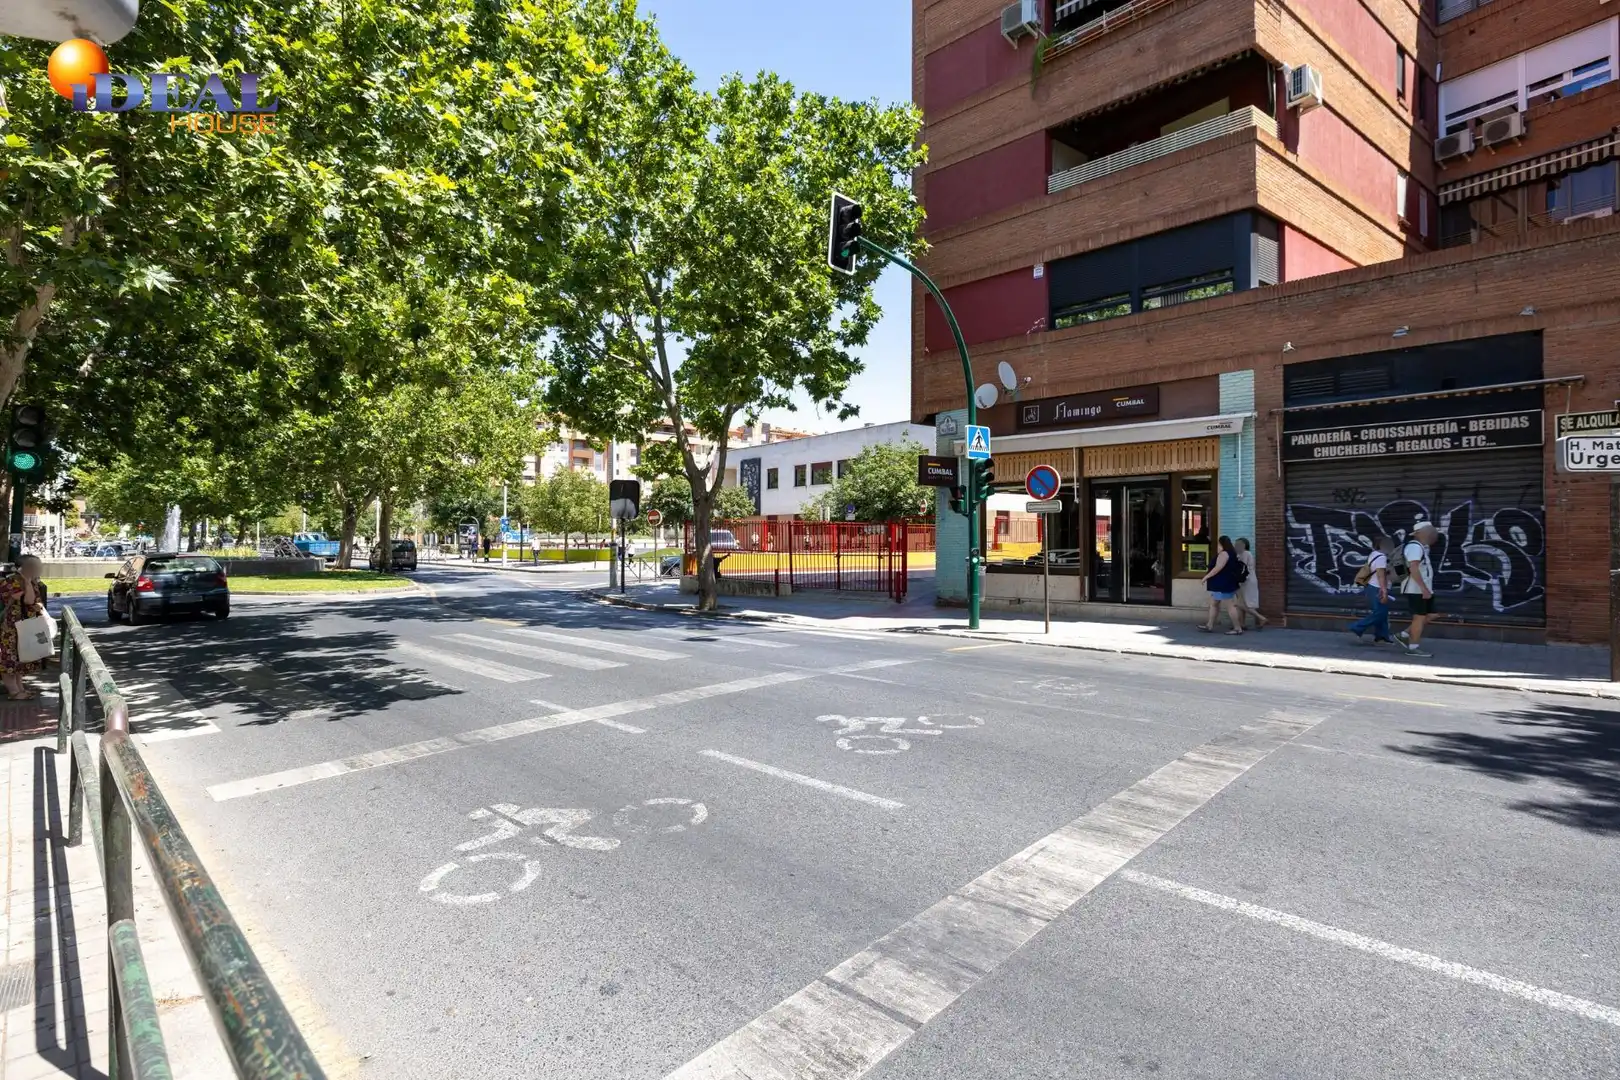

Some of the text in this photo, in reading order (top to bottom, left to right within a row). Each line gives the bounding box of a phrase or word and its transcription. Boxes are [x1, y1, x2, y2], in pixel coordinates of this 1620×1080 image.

[1053, 402, 1102, 421] Flamingo
[1291, 430, 1352, 446] PANADERÍA
[1360, 421, 1459, 440] CROISSANTERÍA
[1469, 416, 1530, 432] BEBIDAS
[1560, 417, 1574, 430] SE
[1313, 441, 1387, 458] CHUCHERÍAS
[1395, 437, 1452, 452] REGALOS
[1462, 434, 1497, 448] ETC...
[927, 467, 953, 476] CUMBAL
